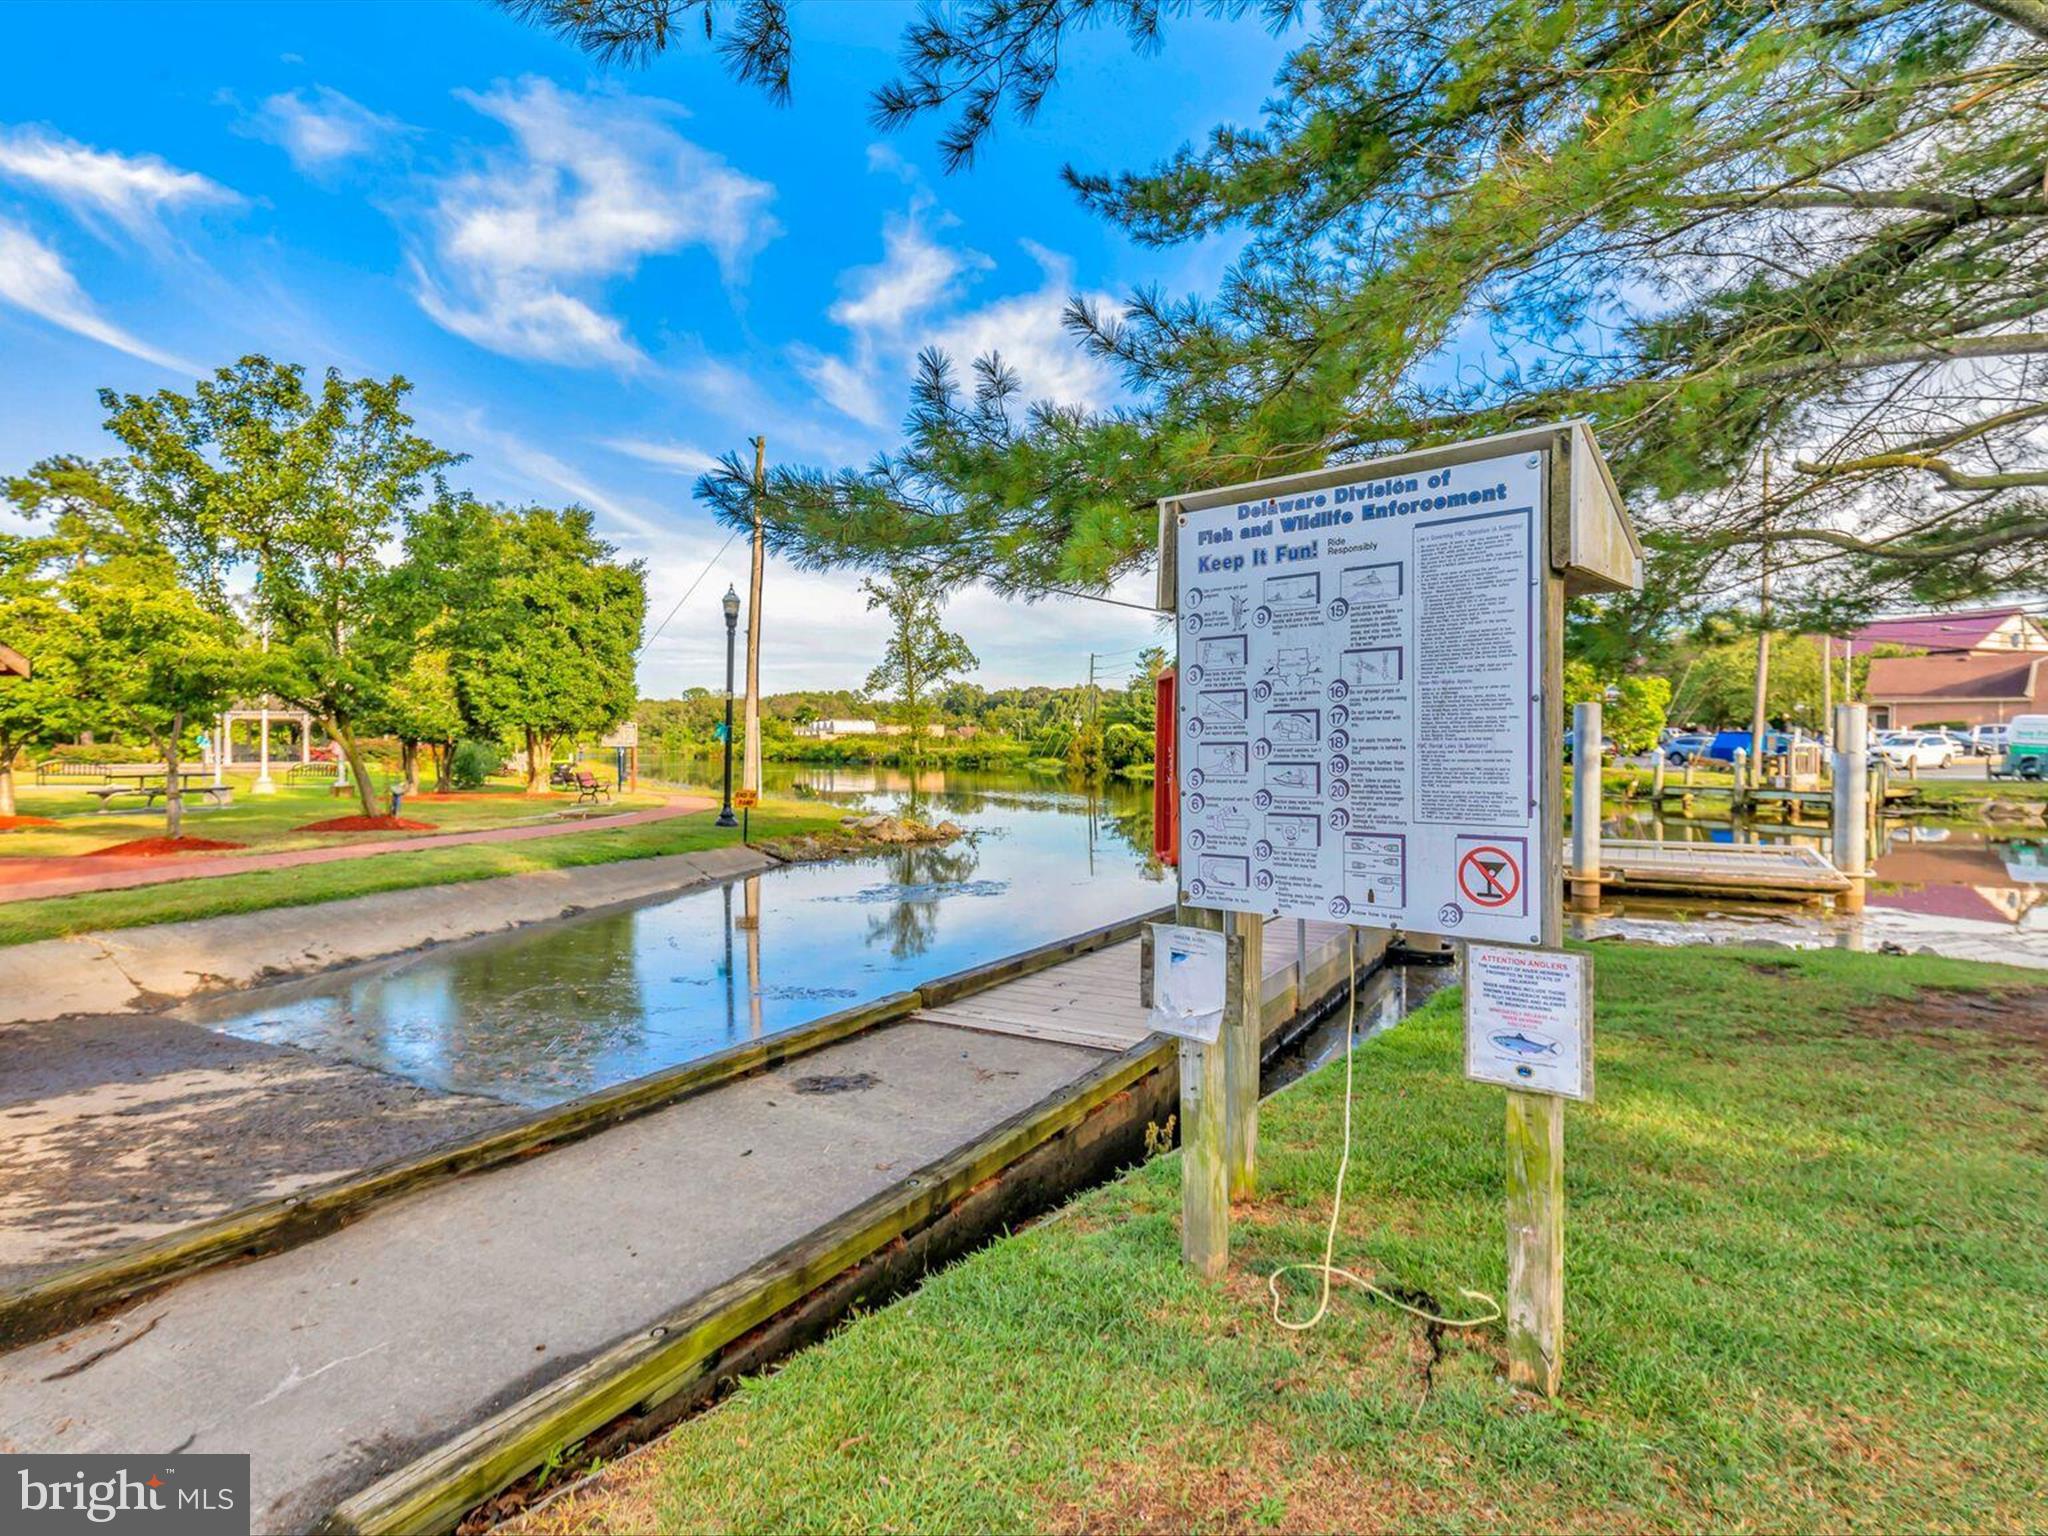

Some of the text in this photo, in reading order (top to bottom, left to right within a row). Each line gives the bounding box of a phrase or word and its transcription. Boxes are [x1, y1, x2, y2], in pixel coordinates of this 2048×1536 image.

[1237, 469, 1452, 520] Delaware Division of
[1197, 482, 1508, 546] Fish and Wildlife Enforcement
[1327, 536, 1346, 548] Ride
[1327, 542, 1378, 556] Responsibly
[1198, 541, 1318, 574] Keep It Fun!
[1190, 594, 1196, 604] 1
[1330, 604, 1344, 617] 15
[1189, 618, 1196, 630] 2
[1257, 612, 1266, 624] 9
[1189, 670, 1198, 682] 3
[1254, 687, 1267, 699] 10
[1330, 686, 1344, 698] 16
[1330, 712, 1344, 724] 17
[1189, 722, 1196, 732] 4
[1329, 736, 1344, 748] 18
[1254, 744, 1266, 756] 11
[1330, 760, 1344, 773] 19
[1192, 775, 1199, 786] 5
[1331, 785, 1345, 798] 20
[1191, 798, 1200, 810] 6
[1256, 794, 1268, 806] 12
[1331, 814, 1344, 826] 21
[1192, 835, 1199, 846] 7
[1256, 846, 1268, 858] 13
[1256, 876, 1268, 888] 14
[1192, 883, 1200, 895] 8
[1332, 902, 1346, 914] 22
[1441, 910, 1458, 923] 23
[1481, 954, 1568, 970] ATTENTION ANGLERS
